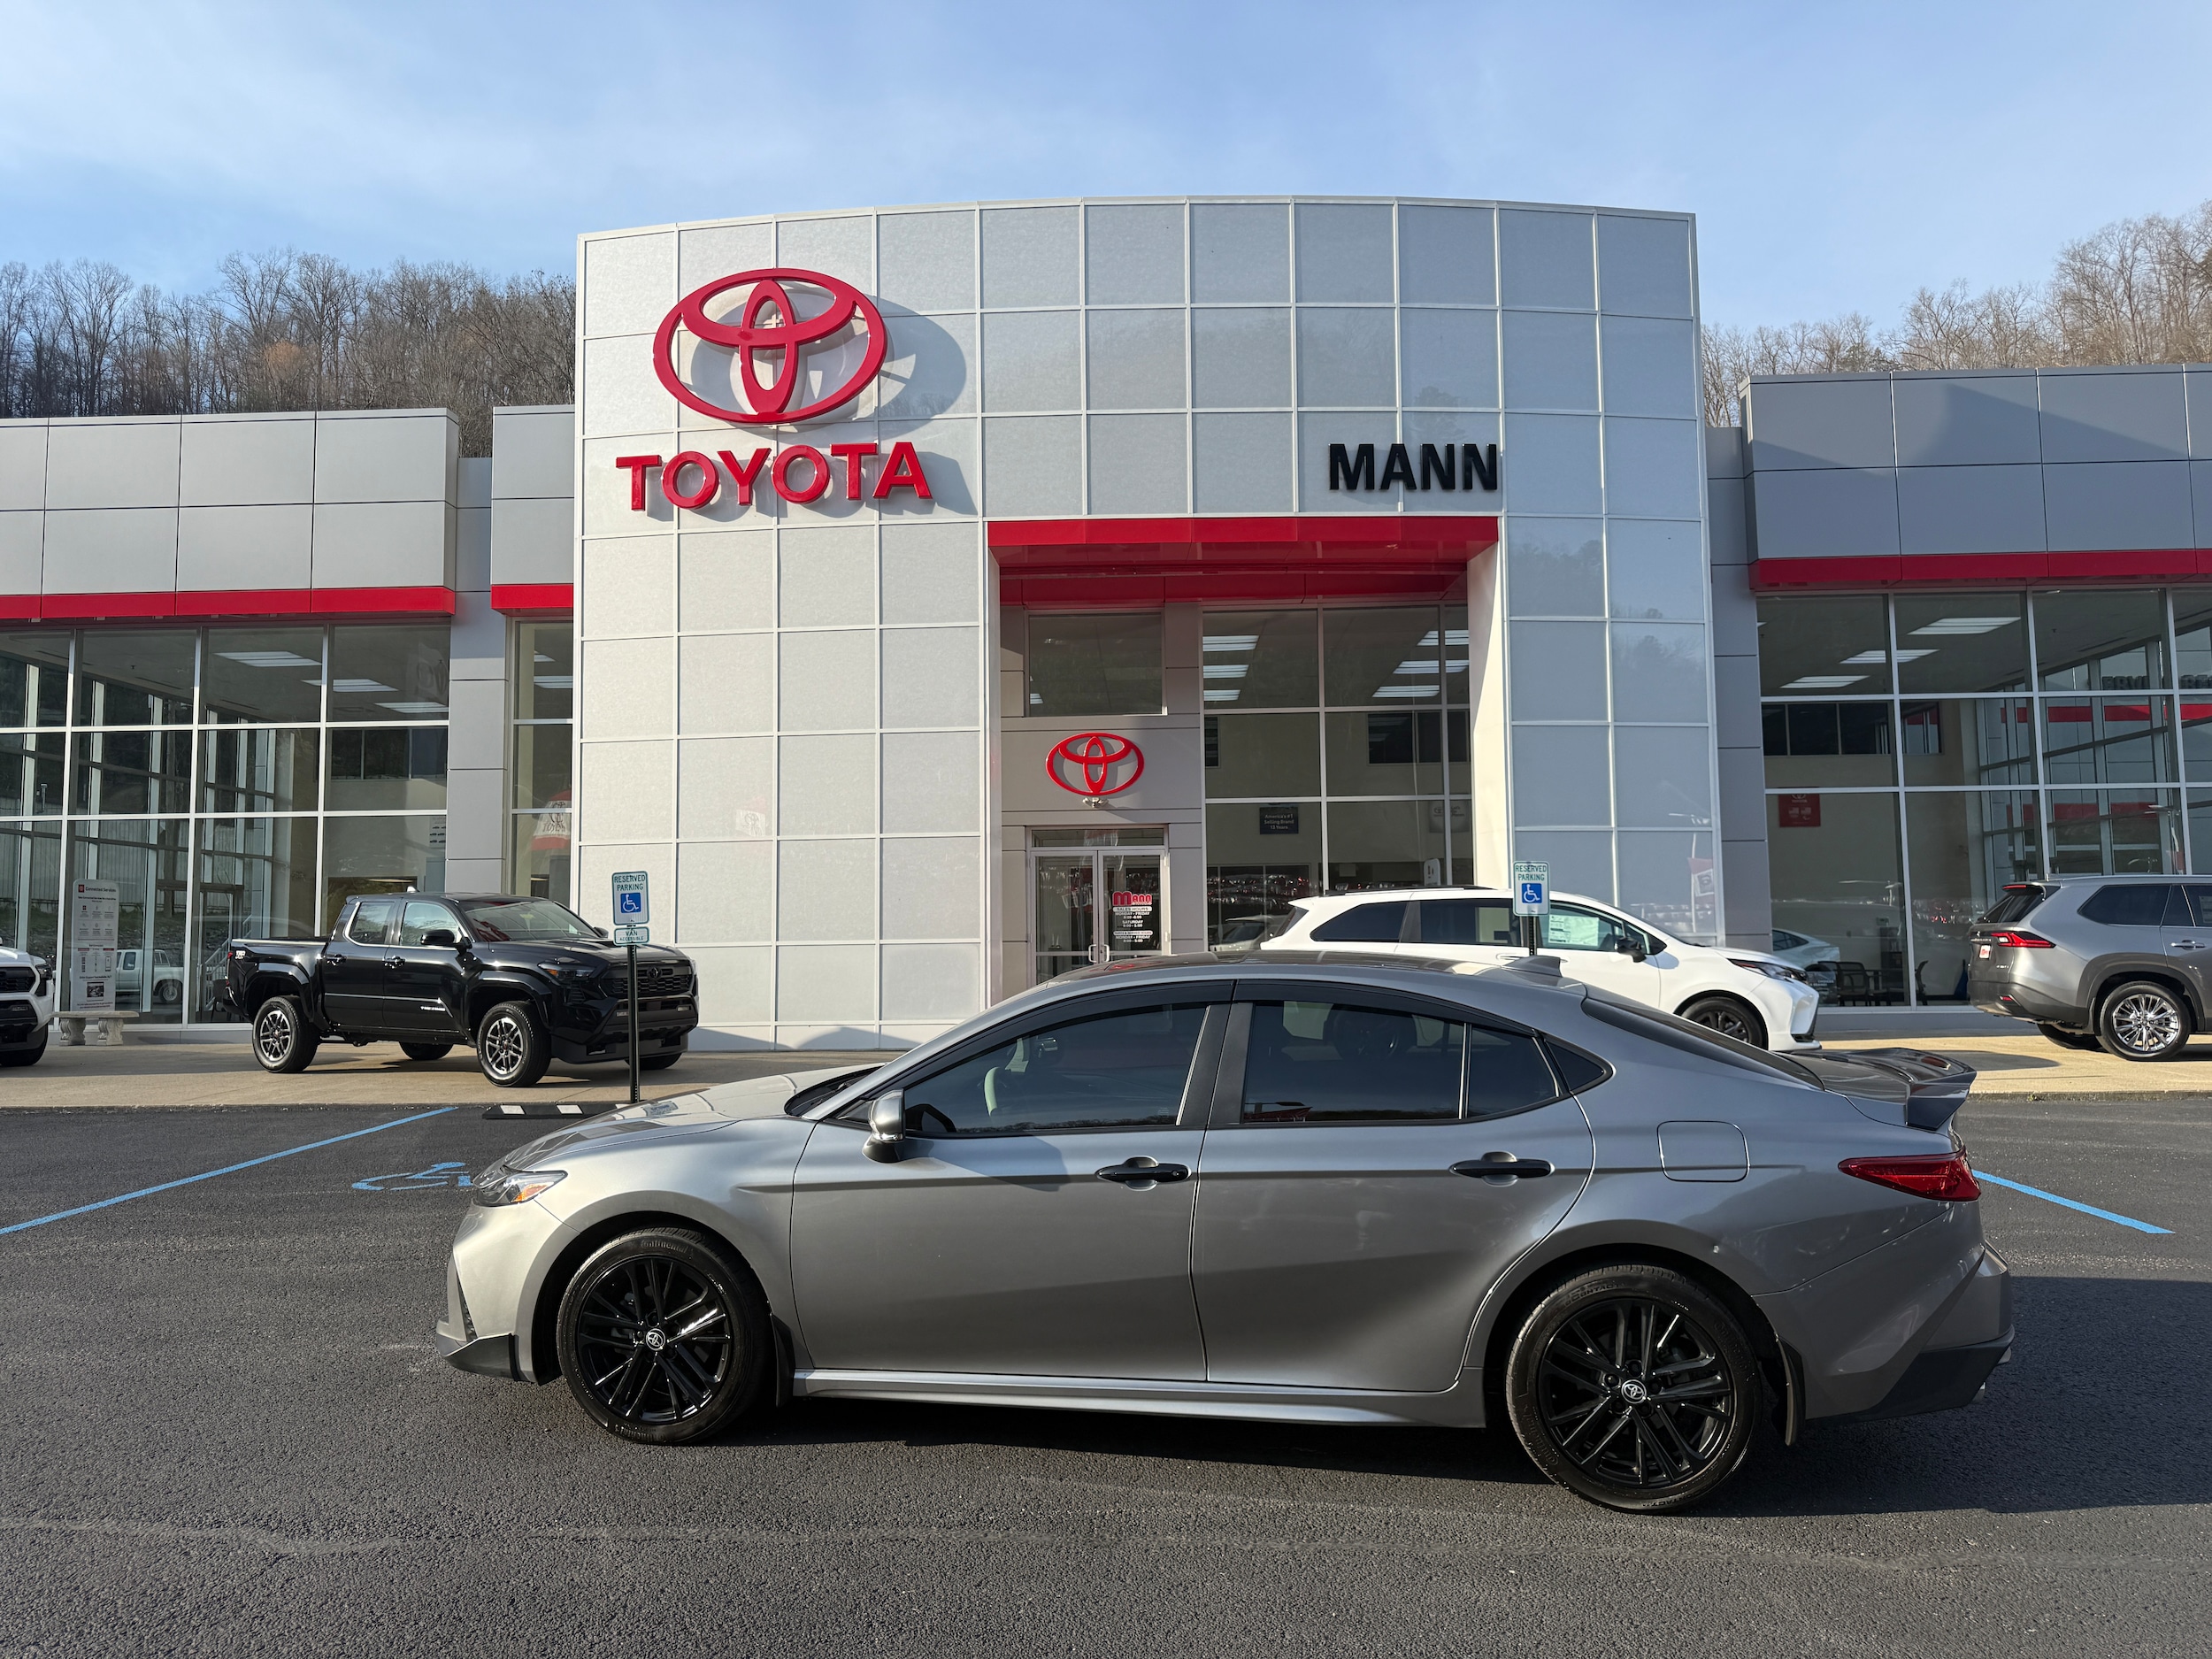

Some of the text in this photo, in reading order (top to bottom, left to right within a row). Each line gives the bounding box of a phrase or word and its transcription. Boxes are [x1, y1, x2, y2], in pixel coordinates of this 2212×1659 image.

[616, 442, 933, 511] TOYOTA
[1329, 443, 1497, 490] MANN
[614, 874, 646, 883] RESERVED
[640, 1240, 688, 1254] Continental
